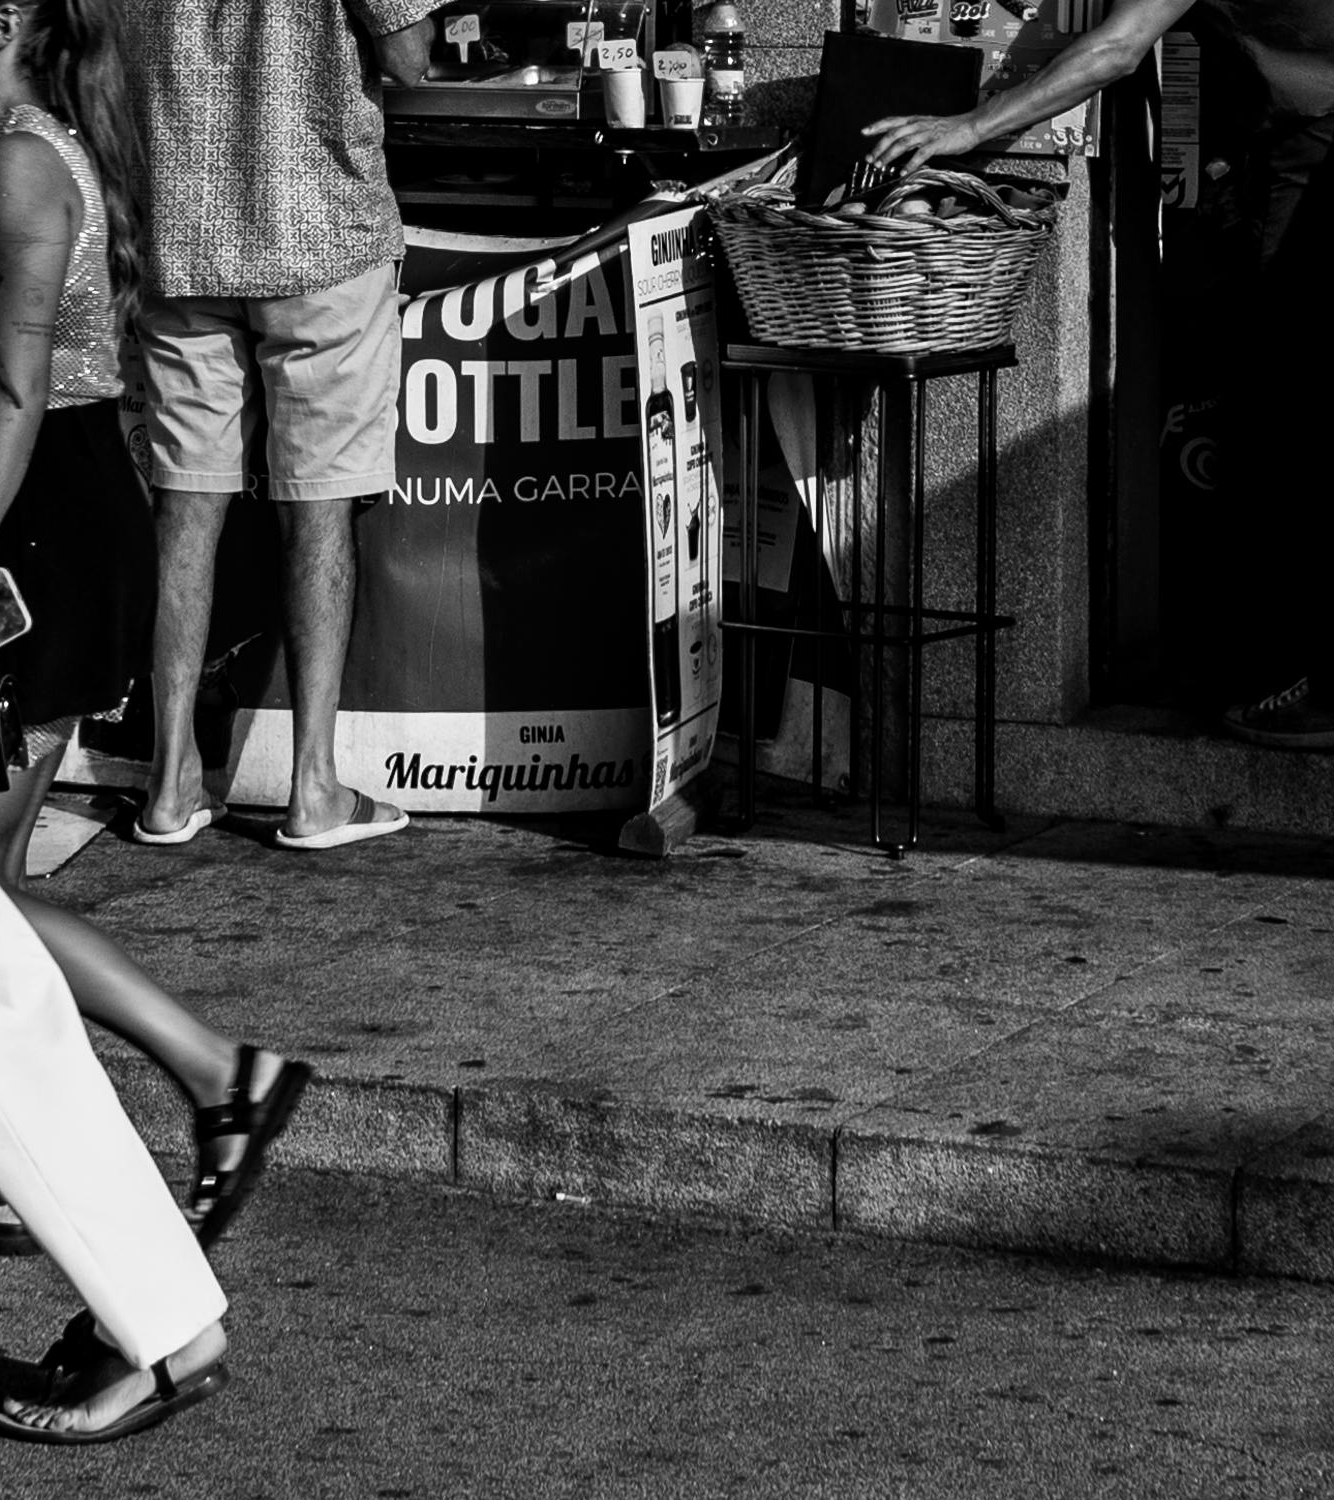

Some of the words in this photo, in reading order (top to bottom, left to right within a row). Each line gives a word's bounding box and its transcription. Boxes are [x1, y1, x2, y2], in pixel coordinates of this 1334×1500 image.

[602, 47, 634, 61] 2,50
[405, 355, 641, 444] OTTLE
[388, 477, 503, 506] NUMA
[519, 725, 565, 743] GINJA
[384, 752, 634, 803] Mariquinhas
